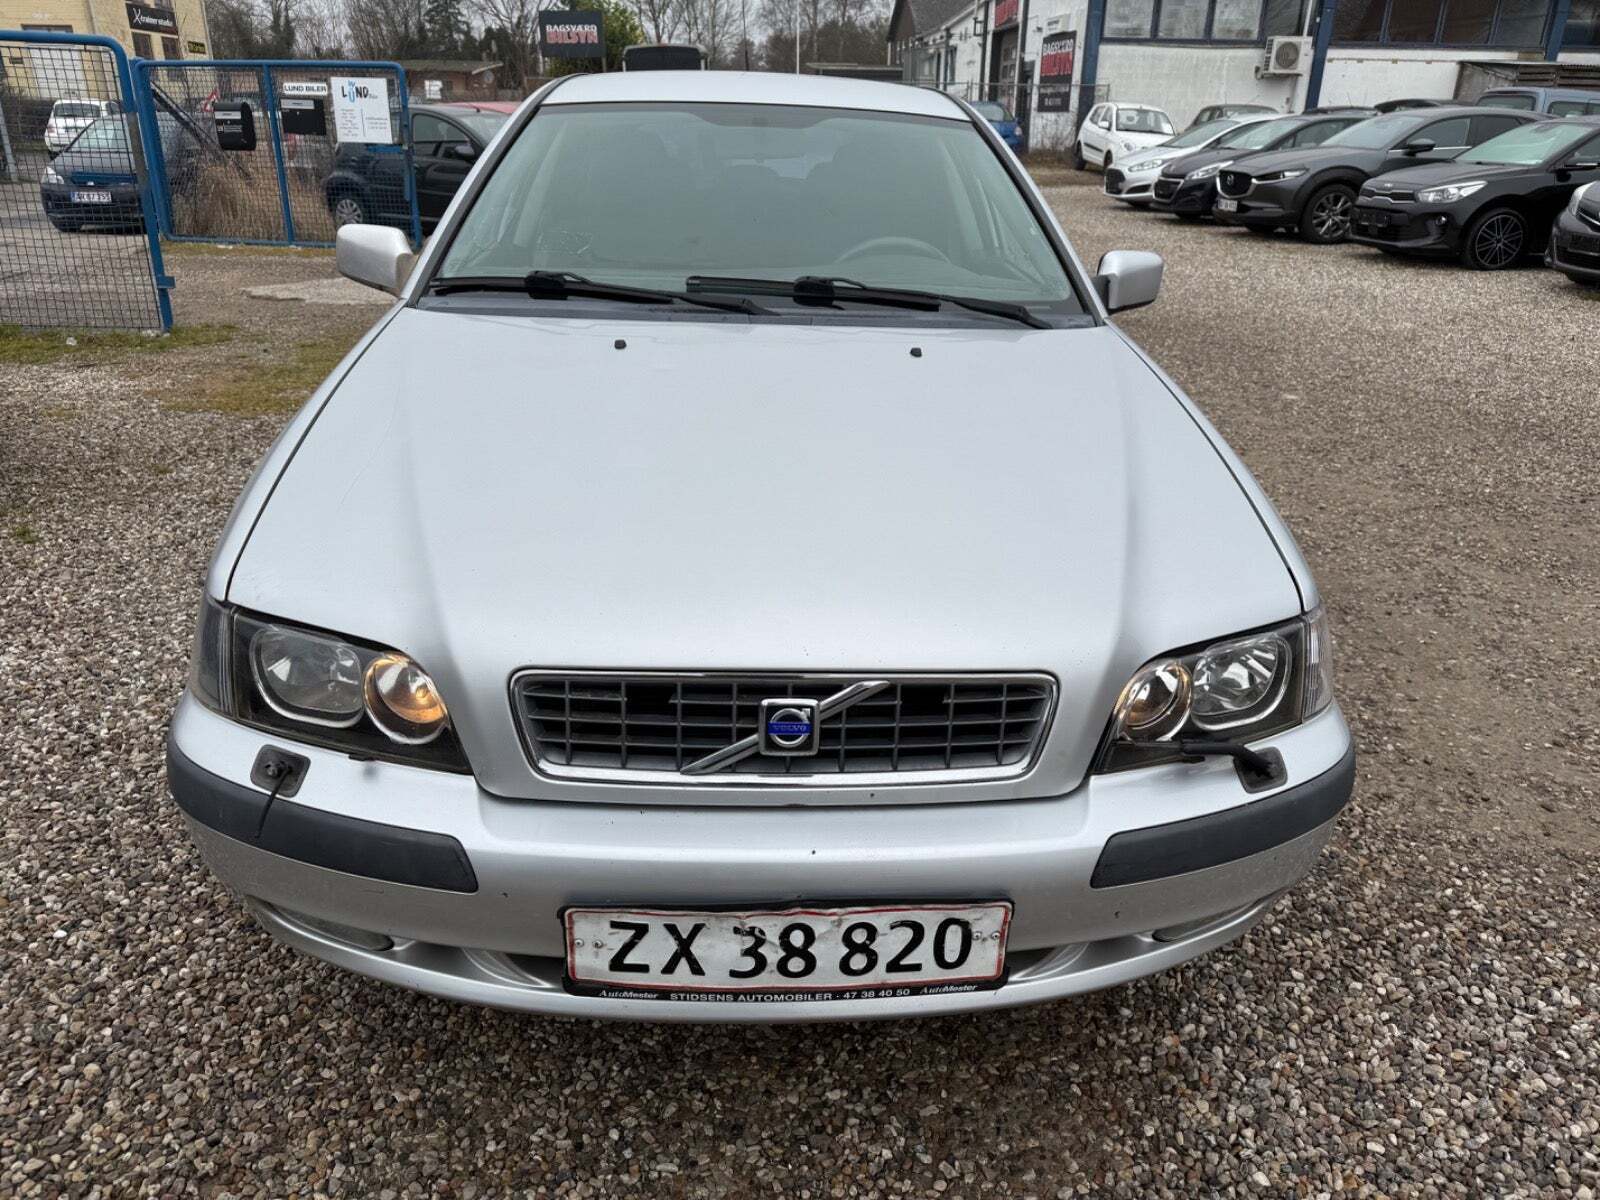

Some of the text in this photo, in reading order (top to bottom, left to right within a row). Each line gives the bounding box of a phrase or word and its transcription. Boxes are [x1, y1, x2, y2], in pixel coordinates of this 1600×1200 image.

[546, 24, 598, 32] BAGSVÆRD
[546, 31, 598, 44] BILSYN
[609, 917, 973, 979] ZX 38 820
[598, 983, 979, 1003] AutoMester STIDSENS AUTOMOBILER 47 38 40 50 AutoMester
